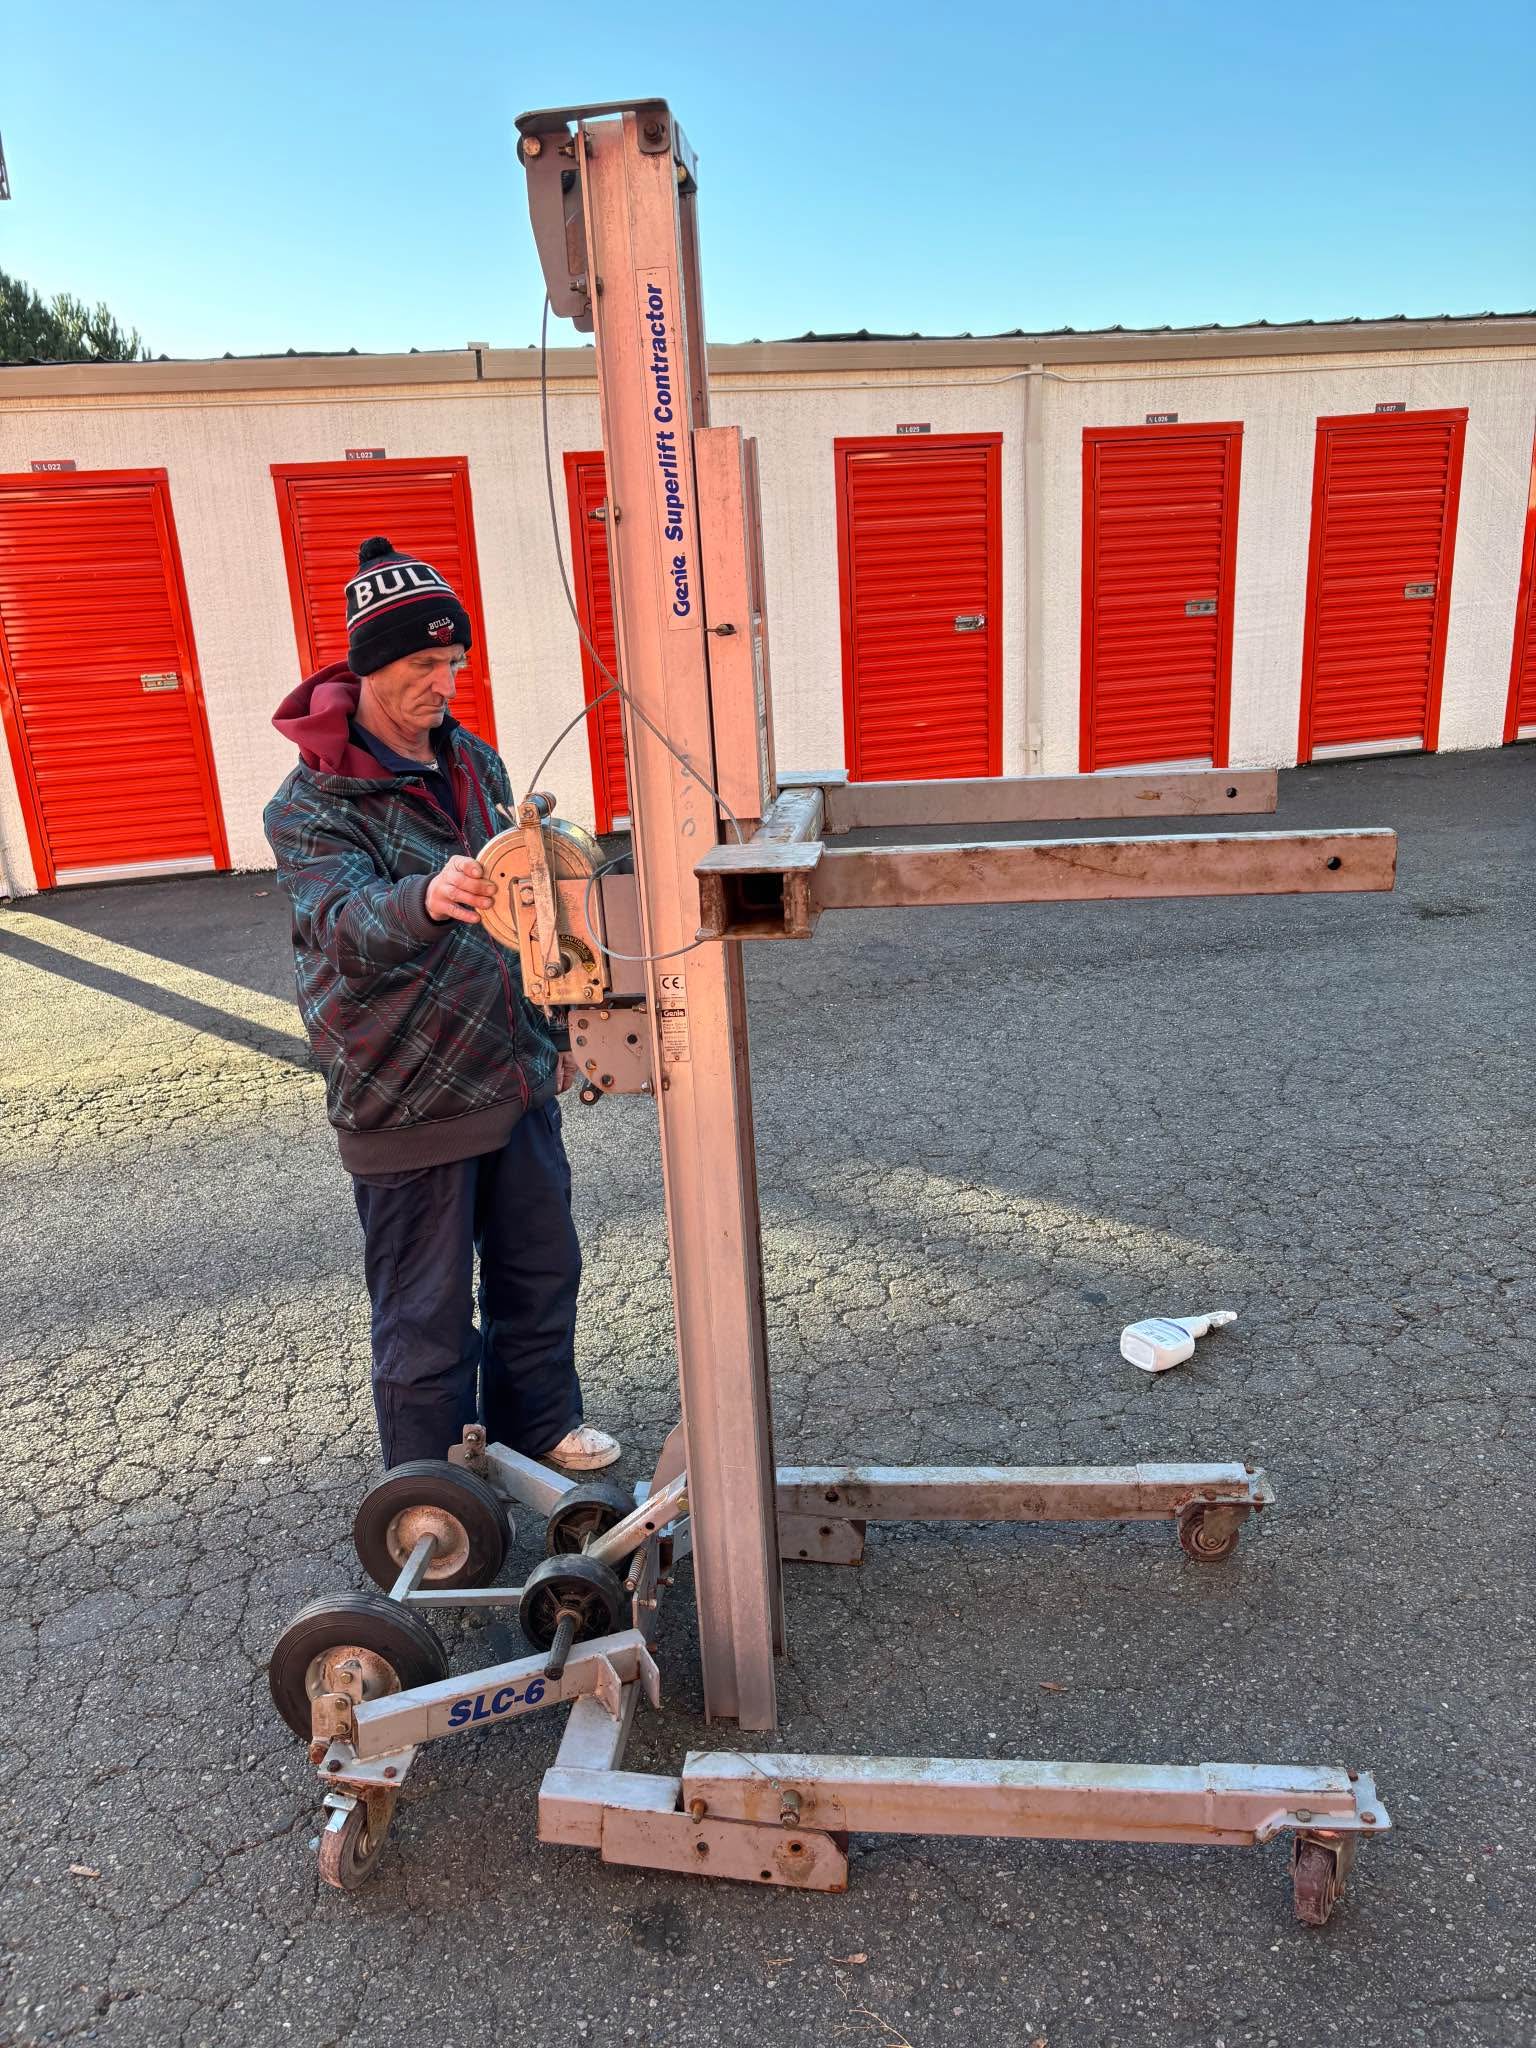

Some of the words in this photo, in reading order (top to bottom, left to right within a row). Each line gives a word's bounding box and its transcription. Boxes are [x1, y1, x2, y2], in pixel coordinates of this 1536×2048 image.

[646, 283, 674, 424] Contractor
[355, 451, 373, 459] L023
[42, 463, 62, 471] L022
[656, 430, 685, 542] Superlift
[670, 555, 690, 617] Genie
[428, 616, 451, 630] BULLS
[561, 934, 586, 950] CAUTION
[663, 1009, 686, 1018] Genie
[447, 1678, 546, 1727] SLC-6
